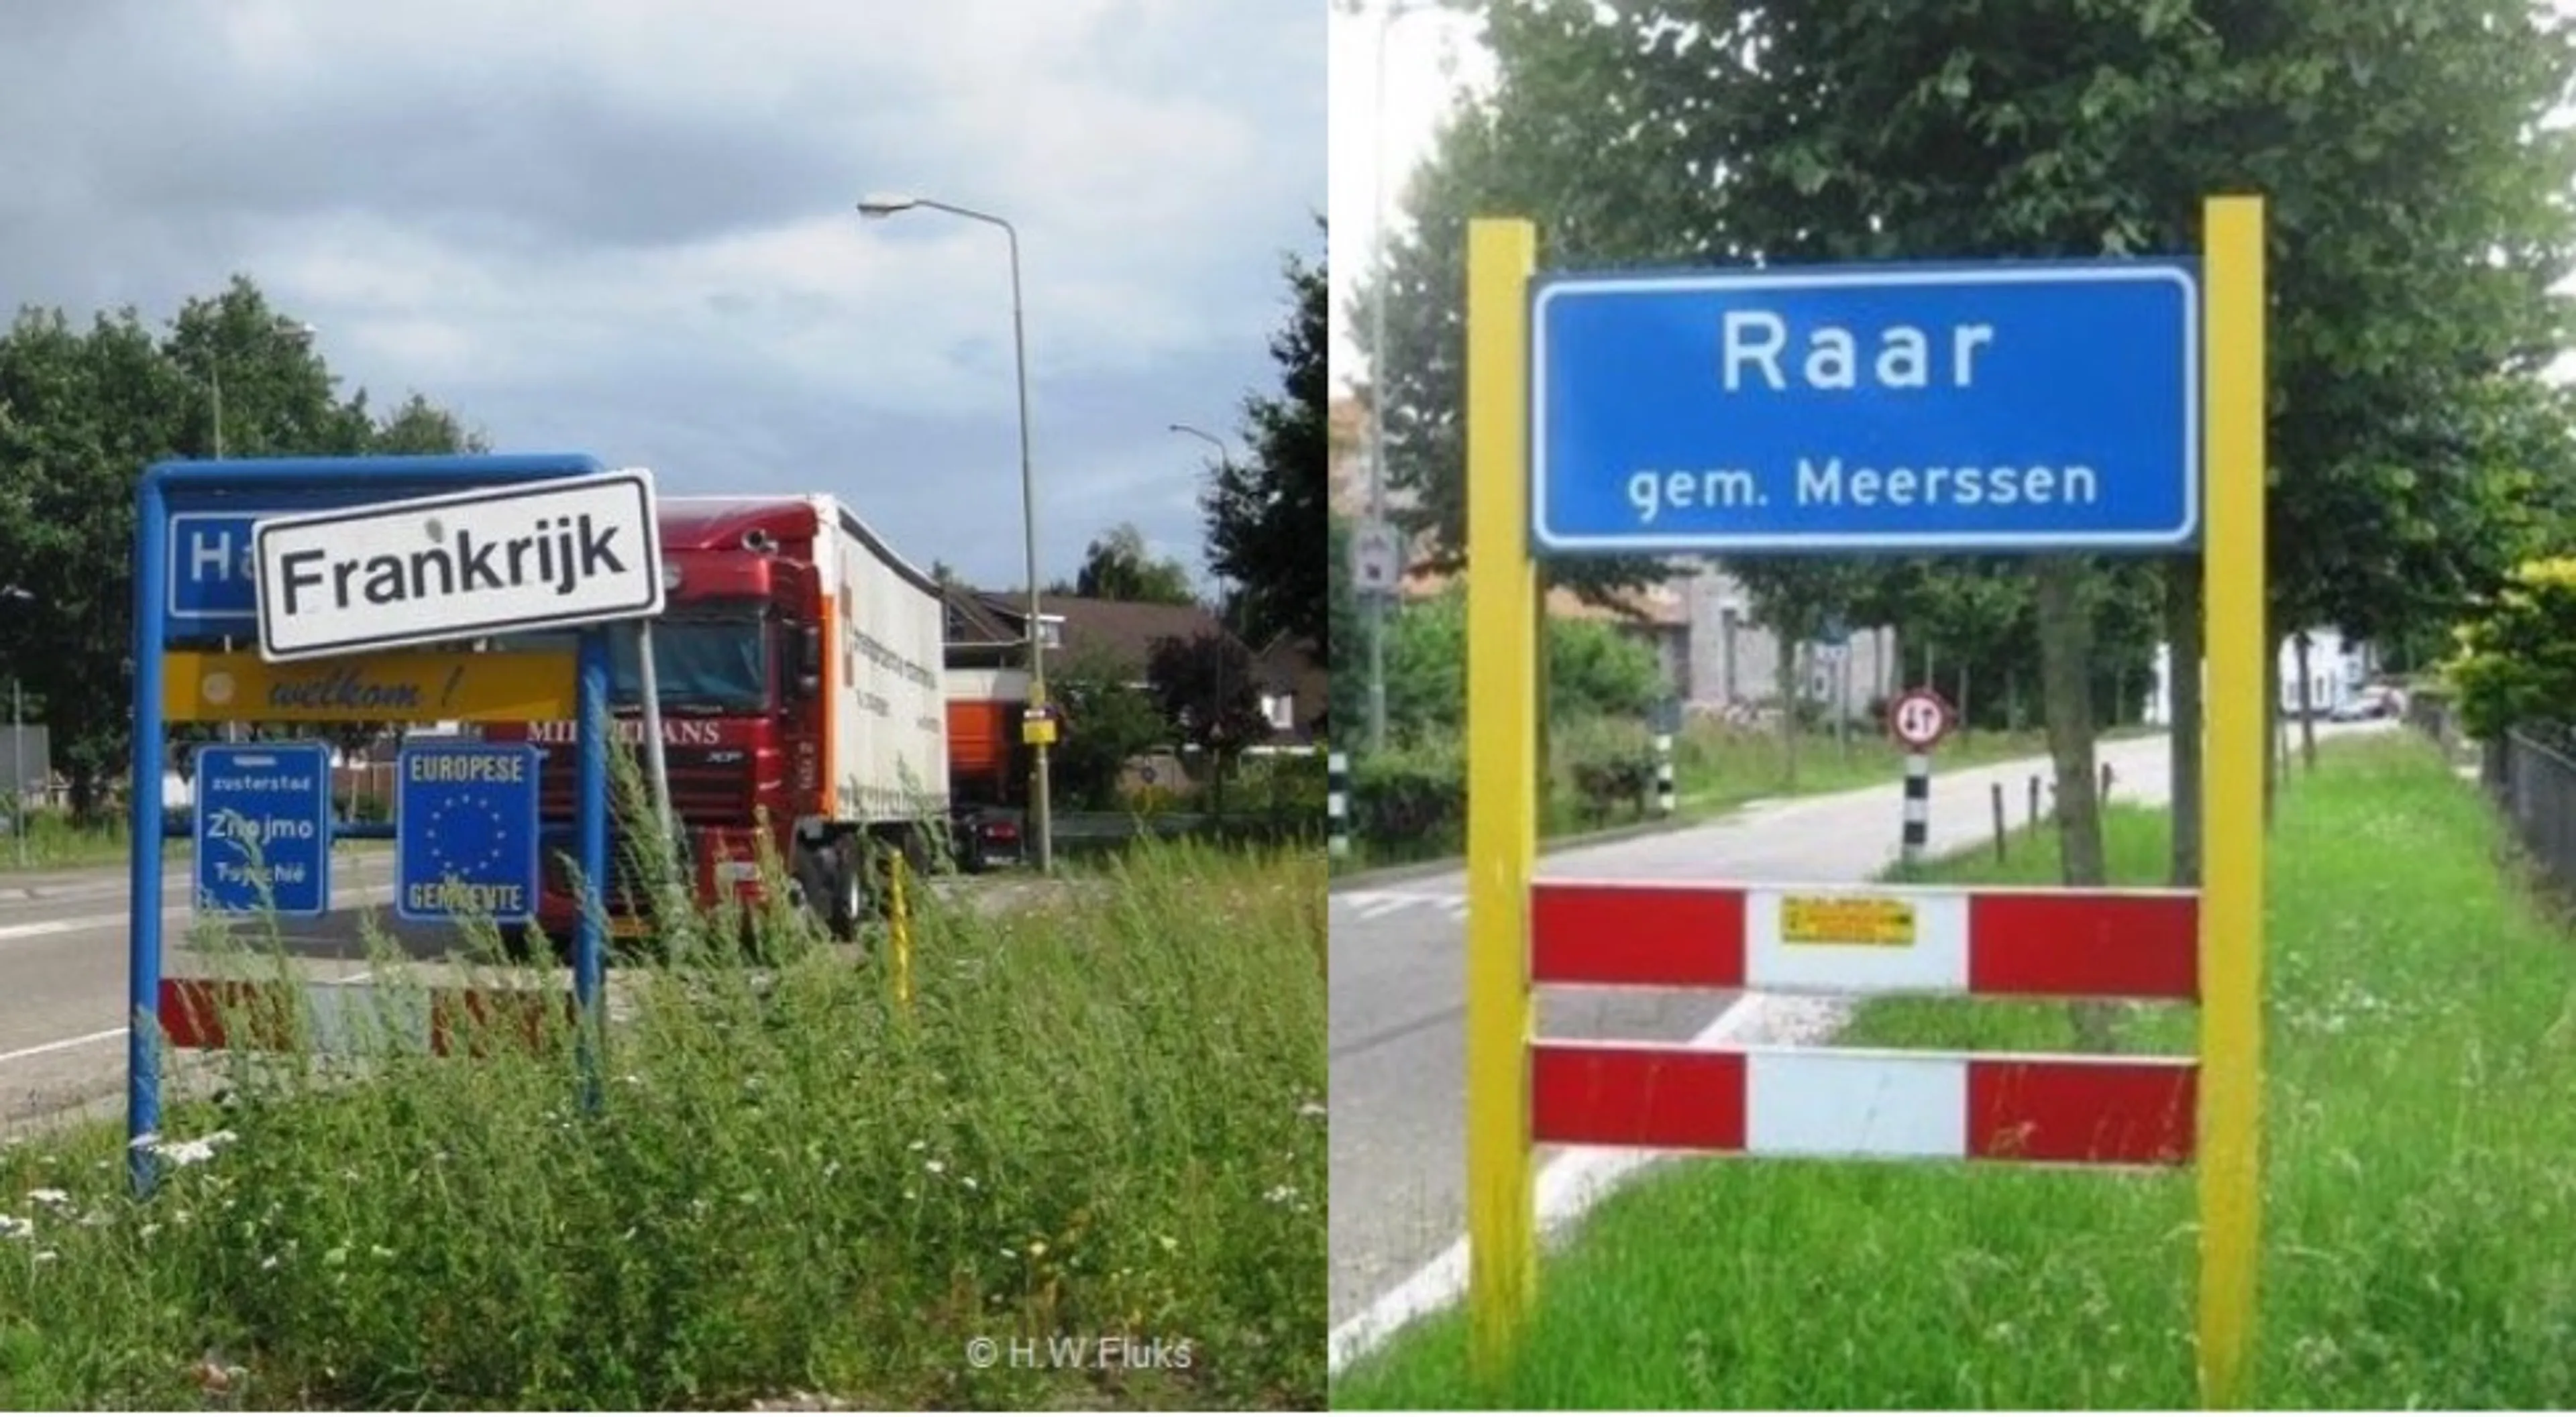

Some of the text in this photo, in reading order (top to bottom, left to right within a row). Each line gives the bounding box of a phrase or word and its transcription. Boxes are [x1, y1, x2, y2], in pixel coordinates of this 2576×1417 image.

[1722, 310, 1993, 392] Raar
[1627, 458, 2096, 525] gem. Meerssen
[280, 513, 627, 615] Frankrijk
[271, 667, 422, 708] welkom
[212, 774, 311, 791] zusterstad
[411, 754, 523, 783] EUROPESE
[409, 883, 523, 911] GEMENTE
